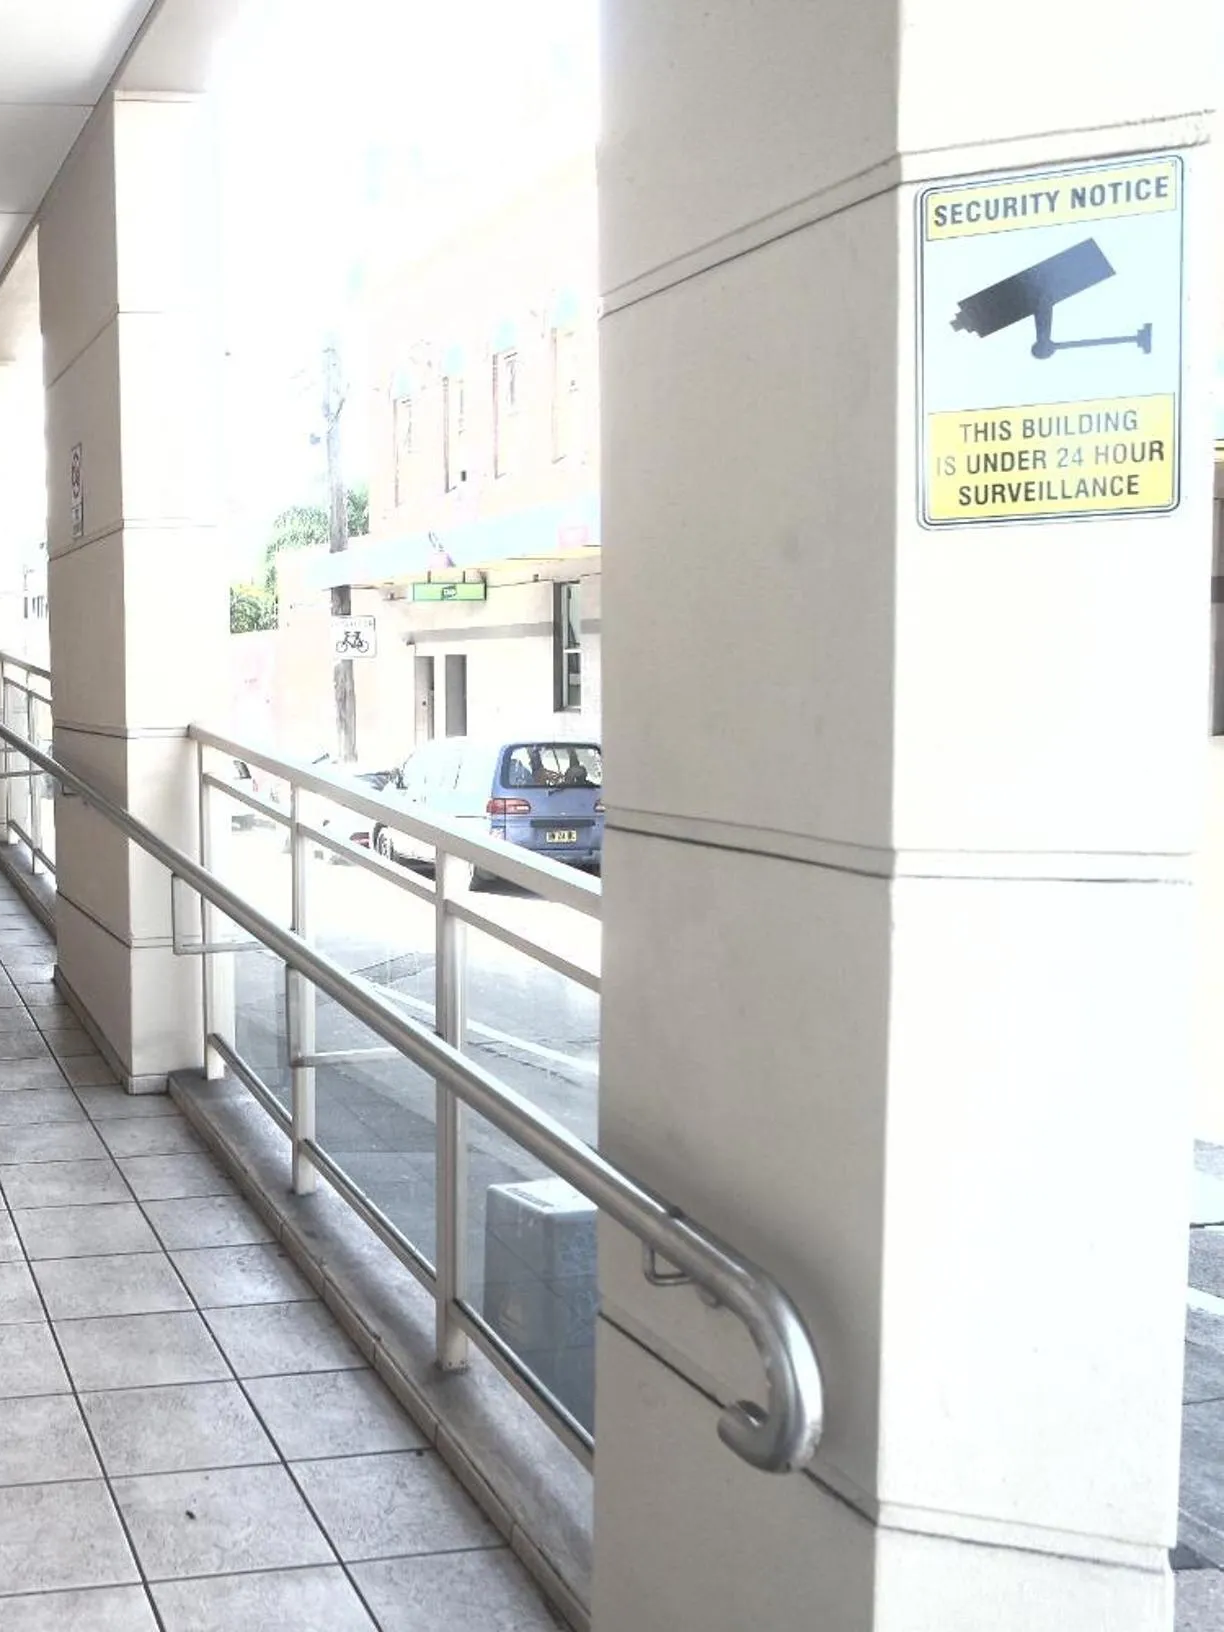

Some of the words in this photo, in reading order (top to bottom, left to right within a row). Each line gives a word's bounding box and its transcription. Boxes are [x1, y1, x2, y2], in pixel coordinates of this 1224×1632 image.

[933, 189, 1061, 228] SECURITY
[1070, 175, 1170, 210] NOTICE
[959, 419, 1013, 444] THIS
[1021, 409, 1139, 440] BUILDING
[935, 455, 958, 477] IS
[966, 449, 1048, 475] UNDER
[1056, 447, 1085, 469] 24
[1093, 439, 1166, 466] HOUR
[958, 473, 1141, 507] SURVEILLANCE
